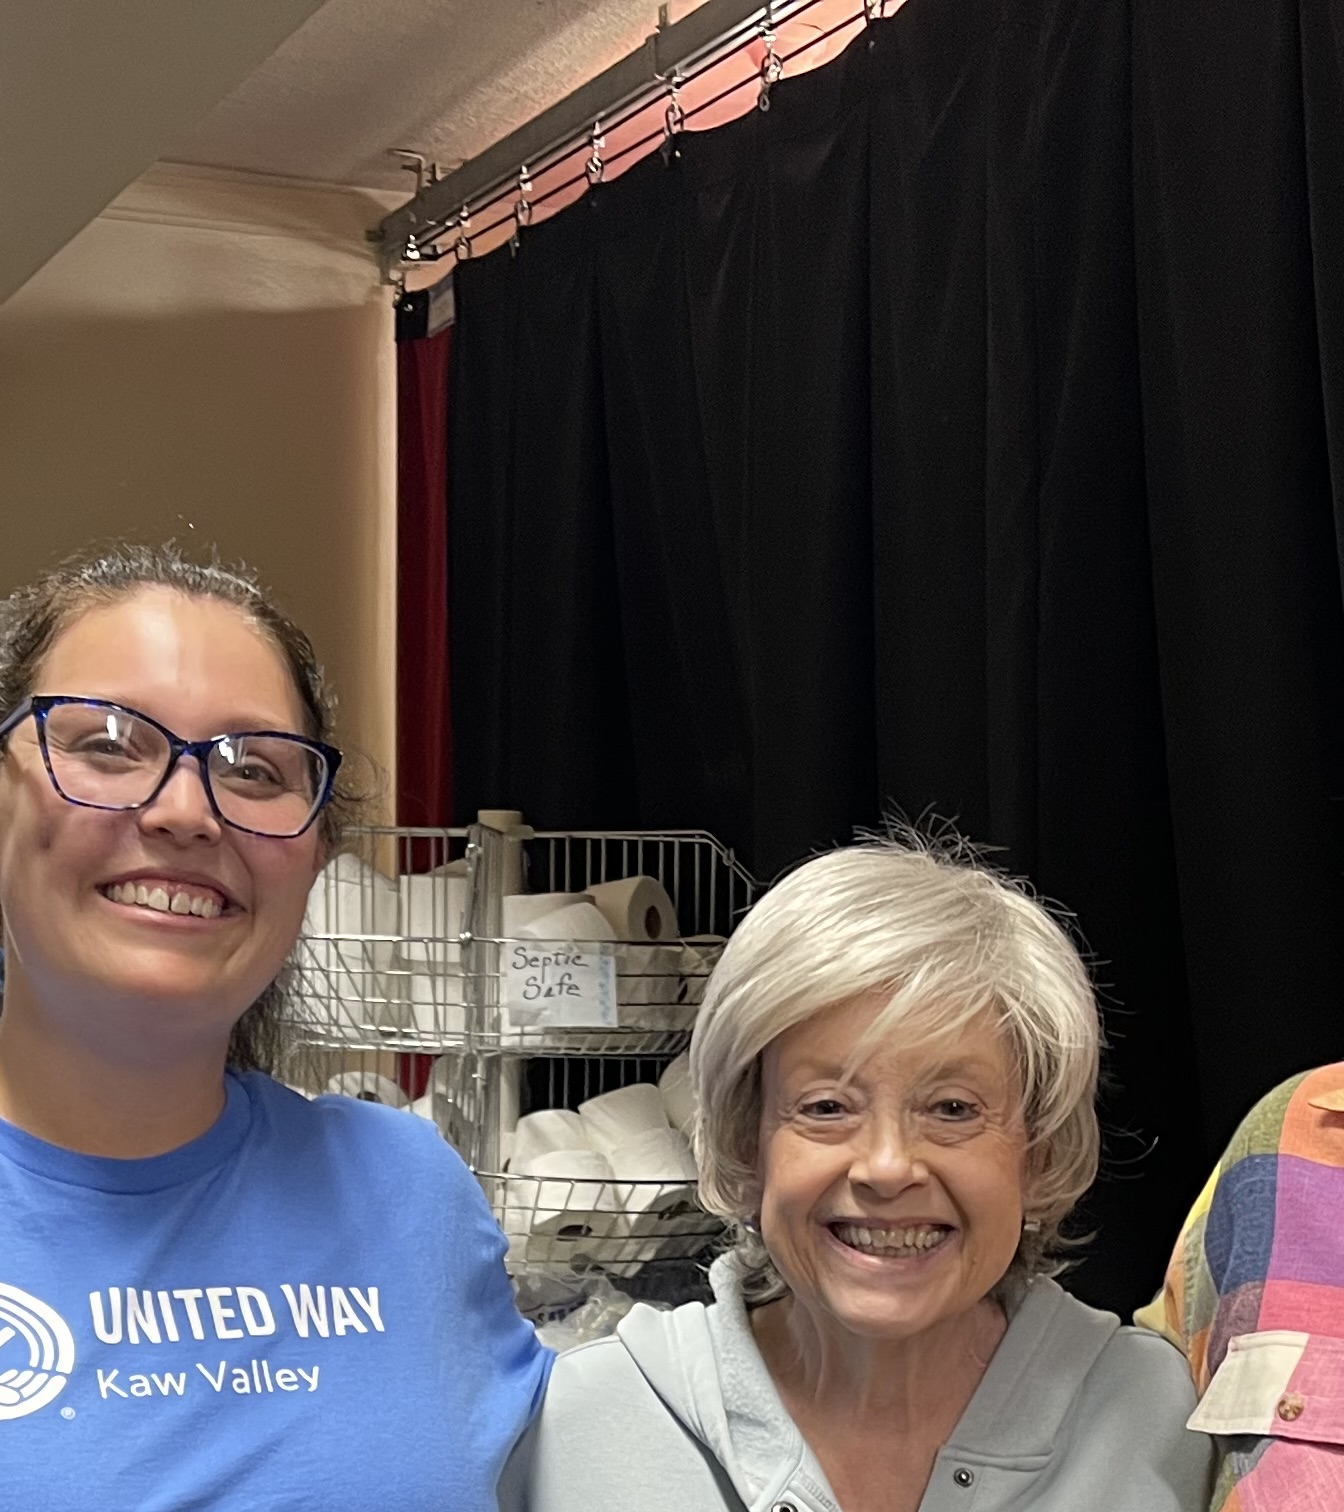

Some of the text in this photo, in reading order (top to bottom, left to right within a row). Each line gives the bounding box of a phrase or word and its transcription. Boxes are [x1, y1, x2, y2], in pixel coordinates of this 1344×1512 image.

[512, 946, 589, 984] Septic
[523, 972, 582, 1000] Safe
[89, 1283, 385, 1344] UNITED WAY
[97, 1359, 319, 1399] Kaw Valley
